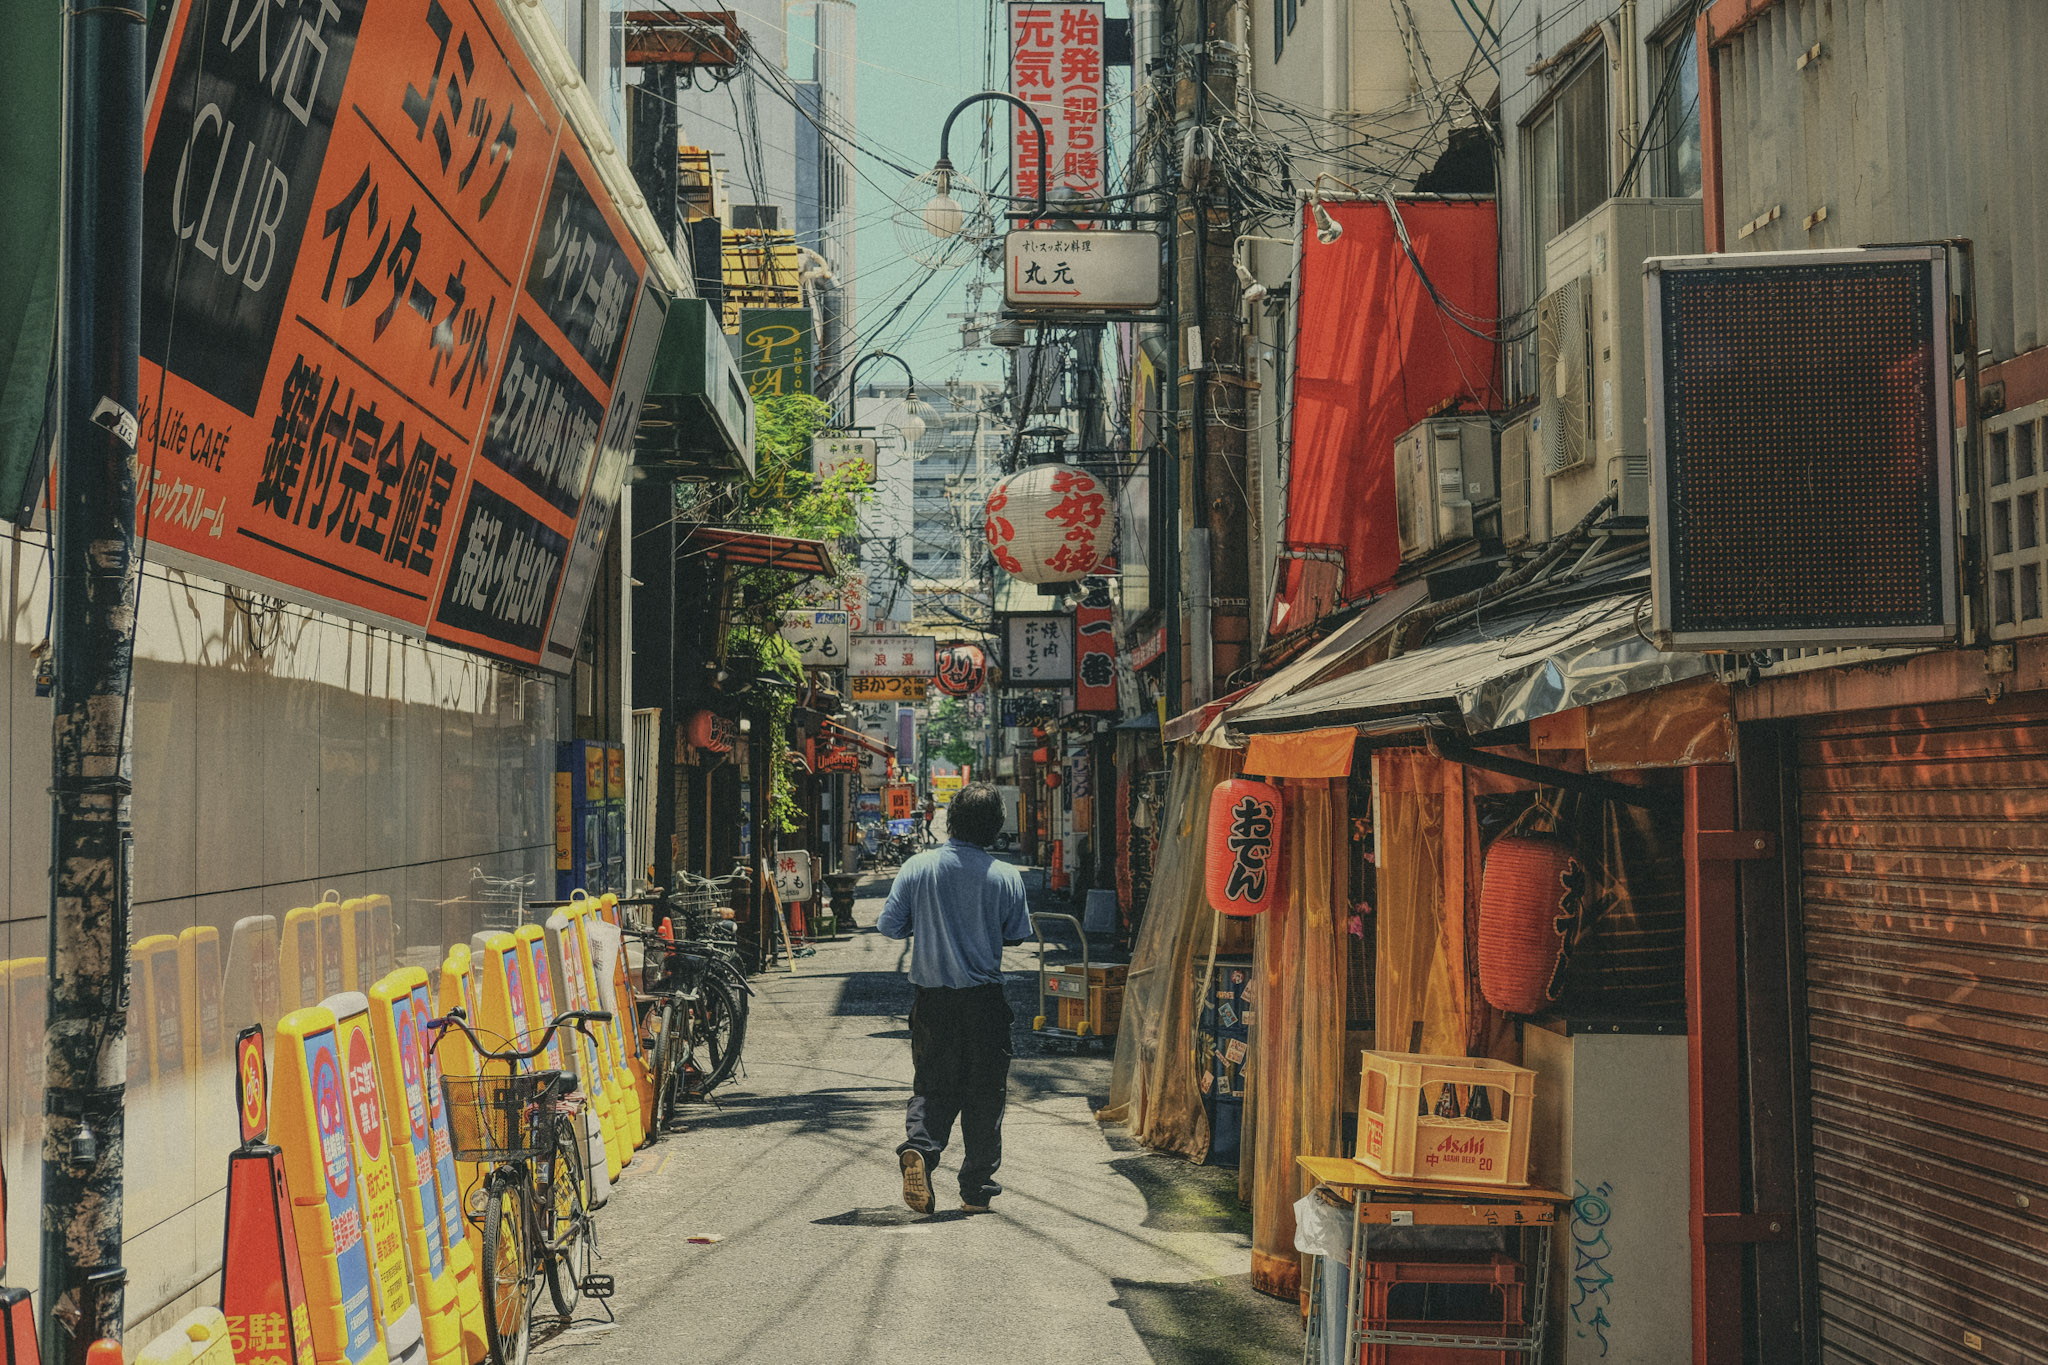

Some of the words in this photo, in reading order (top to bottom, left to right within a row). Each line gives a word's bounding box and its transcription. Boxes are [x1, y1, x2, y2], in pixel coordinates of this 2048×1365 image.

[401, 0, 518, 223] コミック
[172, 102, 289, 292] CLUB
[322, 161, 489, 411] インターネット
[1024, 260, 1075, 285] 丸元
[160, 407, 188, 455] Life
[190, 422, 233, 473] CAFÉ
[252, 353, 458, 577] 鍵付完全個室
[1045, 470, 1106, 573] お好み焼
[1025, 621, 1039, 677] ホルモン
[1041, 622, 1060, 658] 焼肉
[853, 677, 901, 694] 串かつ
[1224, 796, 1275, 903] おでん
[360, 1097, 378, 1134] 禁止
[1426, 1153, 1439, 1168] 中
[1442, 1154, 1460, 1163] ASAHI
[1462, 1156, 1476, 1164] BEER
[1479, 1157, 1493, 1171] 20
[1437, 1134, 1485, 1155] Asahi
[249, 1312, 288, 1365] 駐
